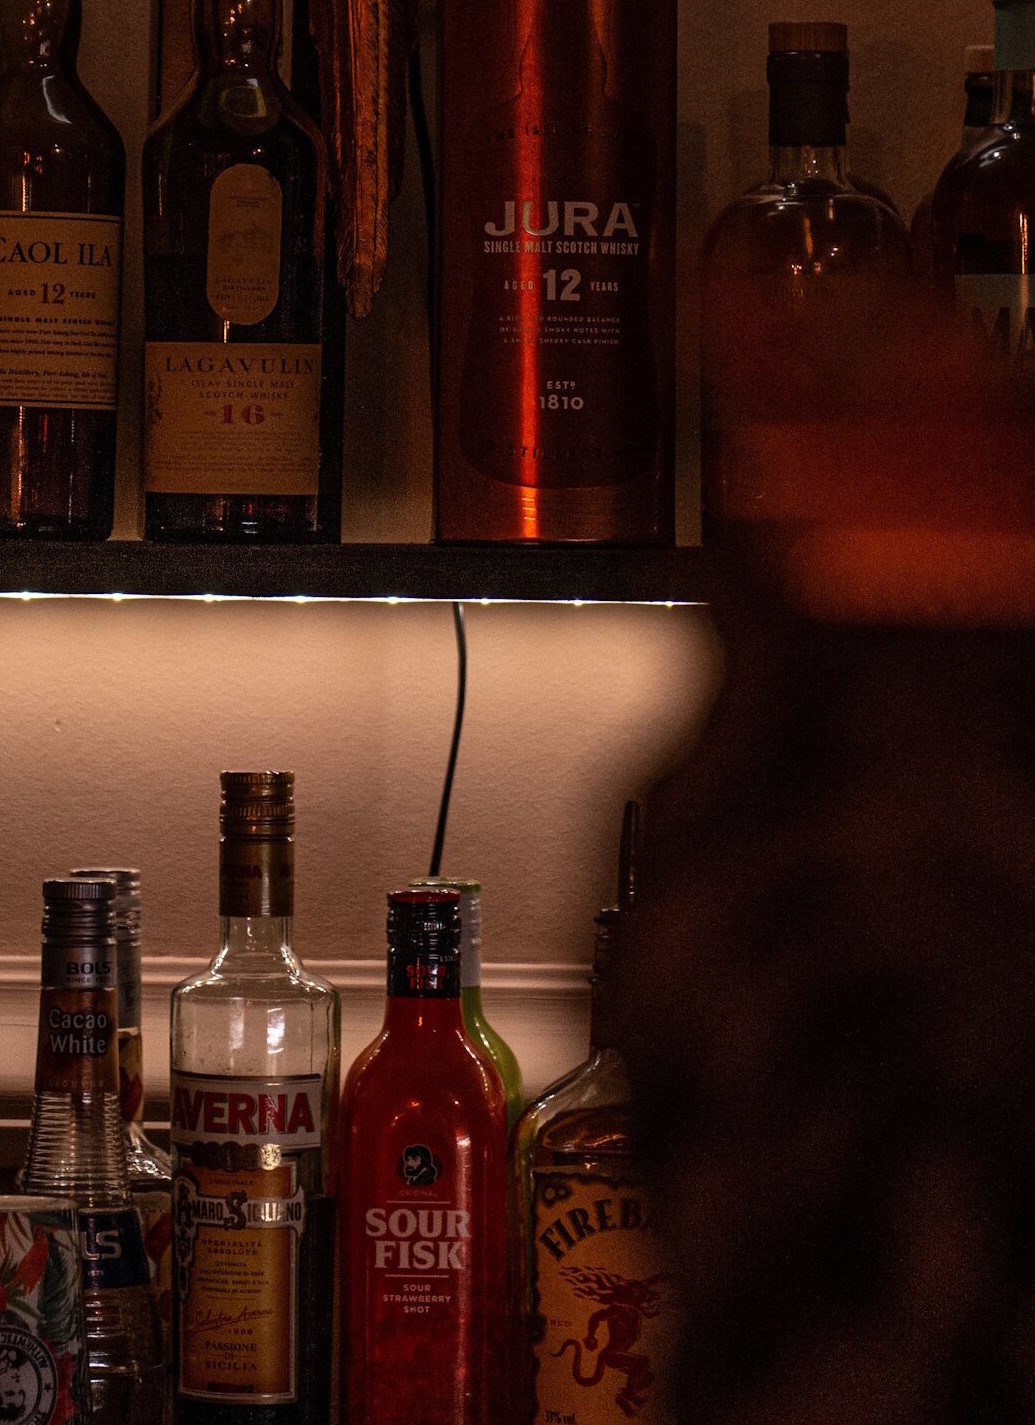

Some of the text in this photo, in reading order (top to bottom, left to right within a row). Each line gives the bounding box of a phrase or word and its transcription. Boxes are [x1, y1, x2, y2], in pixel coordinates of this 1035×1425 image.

[484, 200, 639, 237] JURA
[77, 243, 111, 267] ILA
[484, 241, 640, 256] SINGLE MALT SCOTCH WHISKY
[40, 282, 65, 305] 12
[542, 268, 582, 302] 12
[590, 280, 619, 292] YEARS
[166, 356, 313, 374] LAGAVULIN
[198, 391, 288, 400] SCOTCH WHISKY
[539, 394, 584, 410] 1810
[66, 962, 112, 975] BOLS
[49, 1008, 107, 1029] Cacao
[49, 1033, 107, 1054] White
[172, 1087, 315, 1134] AVERNA
[366, 1208, 471, 1238] SOUR
[540, 1198, 651, 1262] FIREB
[81, 1230, 123, 1261] LS
[374, 1240, 465, 1270] FISK
[402, 1283, 432, 1292] SOUR
[382, 1294, 452, 1303] STRAWBERRY
[403, 1305, 431, 1314] SHOT
[205, 1342, 258, 1352] PASSIONE
[205, 1362, 258, 1371] SICILIA
